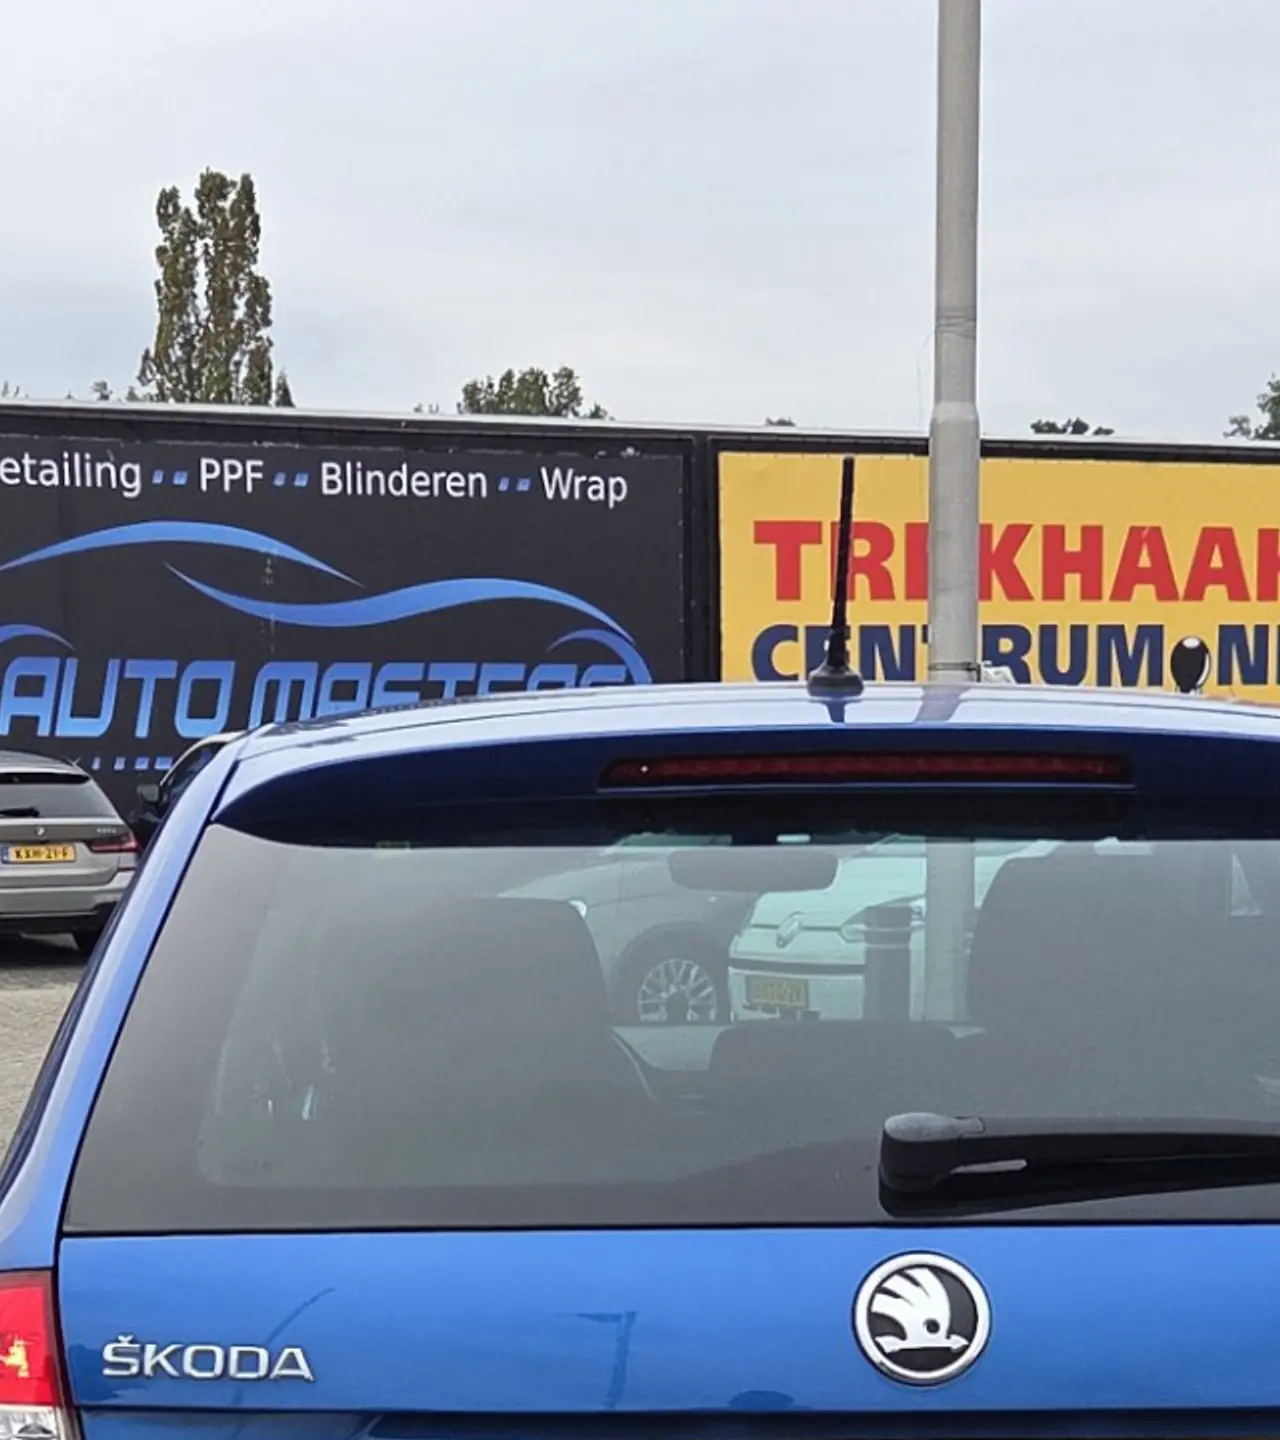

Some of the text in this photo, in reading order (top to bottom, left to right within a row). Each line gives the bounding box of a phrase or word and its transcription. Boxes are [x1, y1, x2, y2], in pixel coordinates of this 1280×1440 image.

[199, 457, 264, 493] PPF
[320, 451, 487, 498] Blinderen
[540, 457, 628, 509] Wrap
[102, 1334, 317, 1382] ŠKODA
